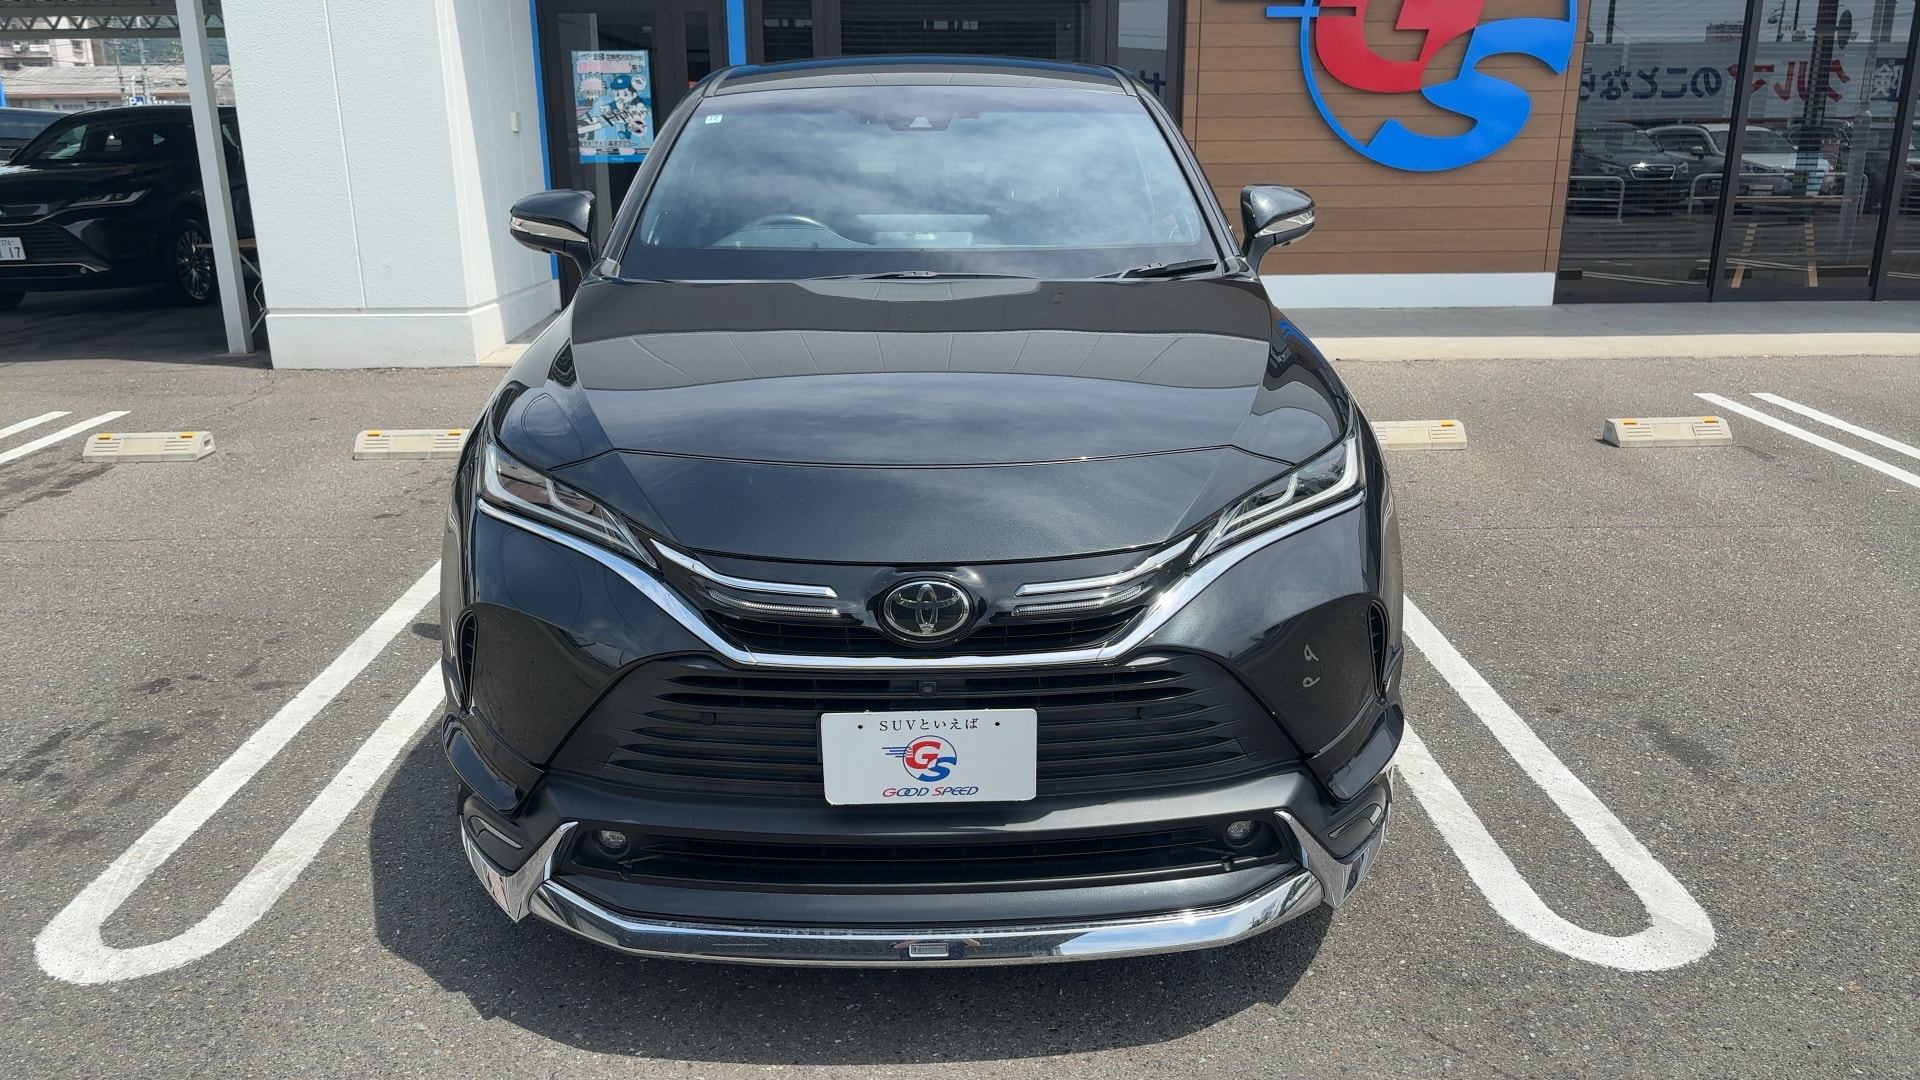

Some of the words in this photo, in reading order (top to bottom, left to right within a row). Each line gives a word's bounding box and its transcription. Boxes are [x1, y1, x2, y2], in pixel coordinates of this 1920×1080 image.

[879, 717, 979, 732] SUVといえば
[905, 740, 957, 782] GS
[882, 787, 930, 797] GOOD
[932, 786, 979, 796] SPEED
